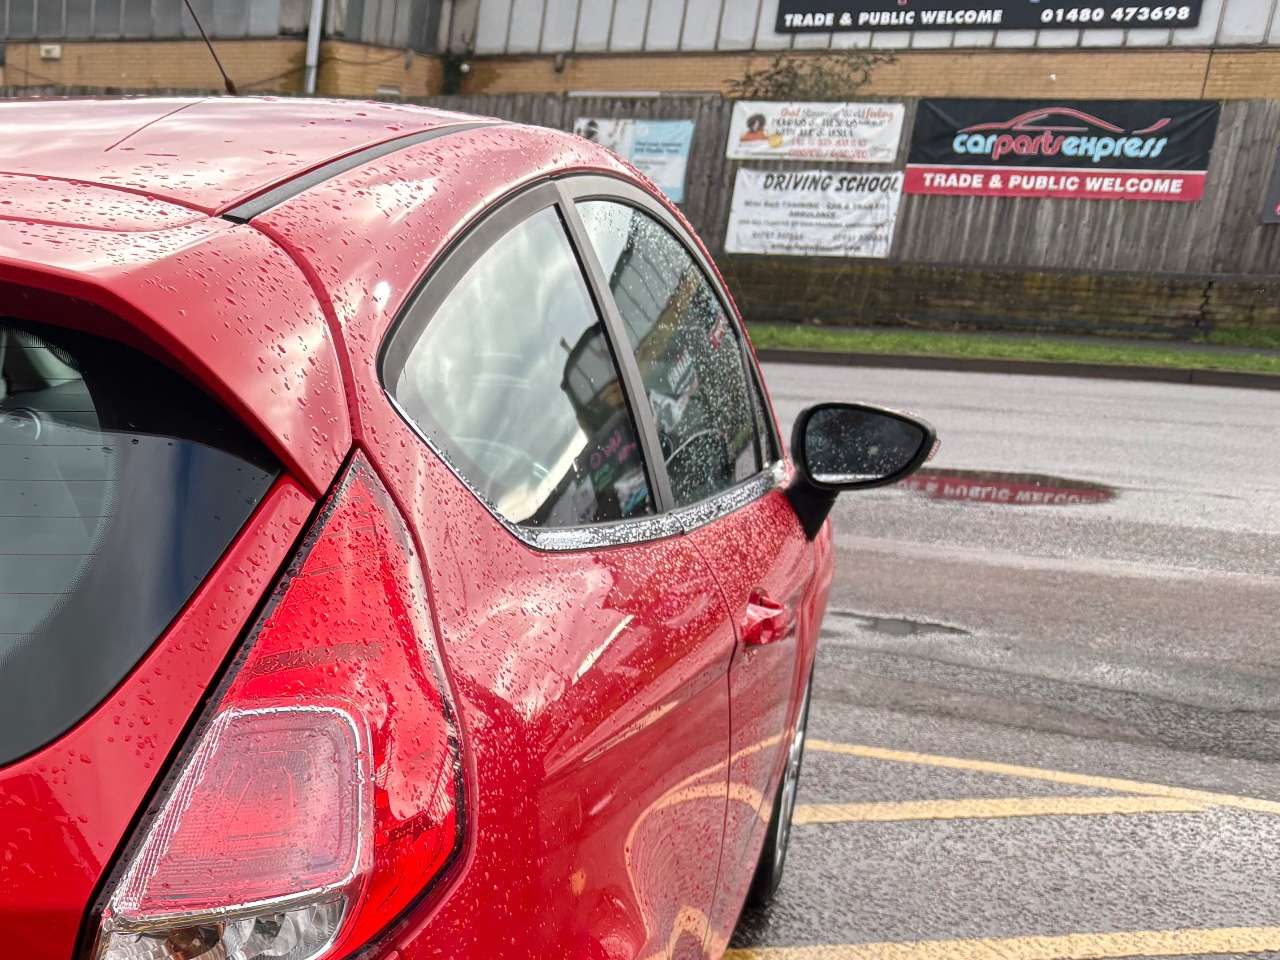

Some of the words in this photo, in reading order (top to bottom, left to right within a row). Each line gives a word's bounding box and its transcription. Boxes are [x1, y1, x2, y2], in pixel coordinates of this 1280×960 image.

[784, 13, 834, 27] TRADE
[839, 12, 852, 26] &
[858, 10, 915, 25] PUBLIC
[920, 9, 1003, 24] WELCOME
[1040, 8, 1105, 23] 01480
[1110, 6, 1190, 21] 473698
[763, 174, 832, 190] DRIVING
[835, 175, 898, 192] SCHOOL
[923, 172, 983, 188] TRADE
[989, 174, 1002, 189] &
[1008, 176, 1079, 191] PUBLIC
[1085, 177, 1183, 193] WELCOME
